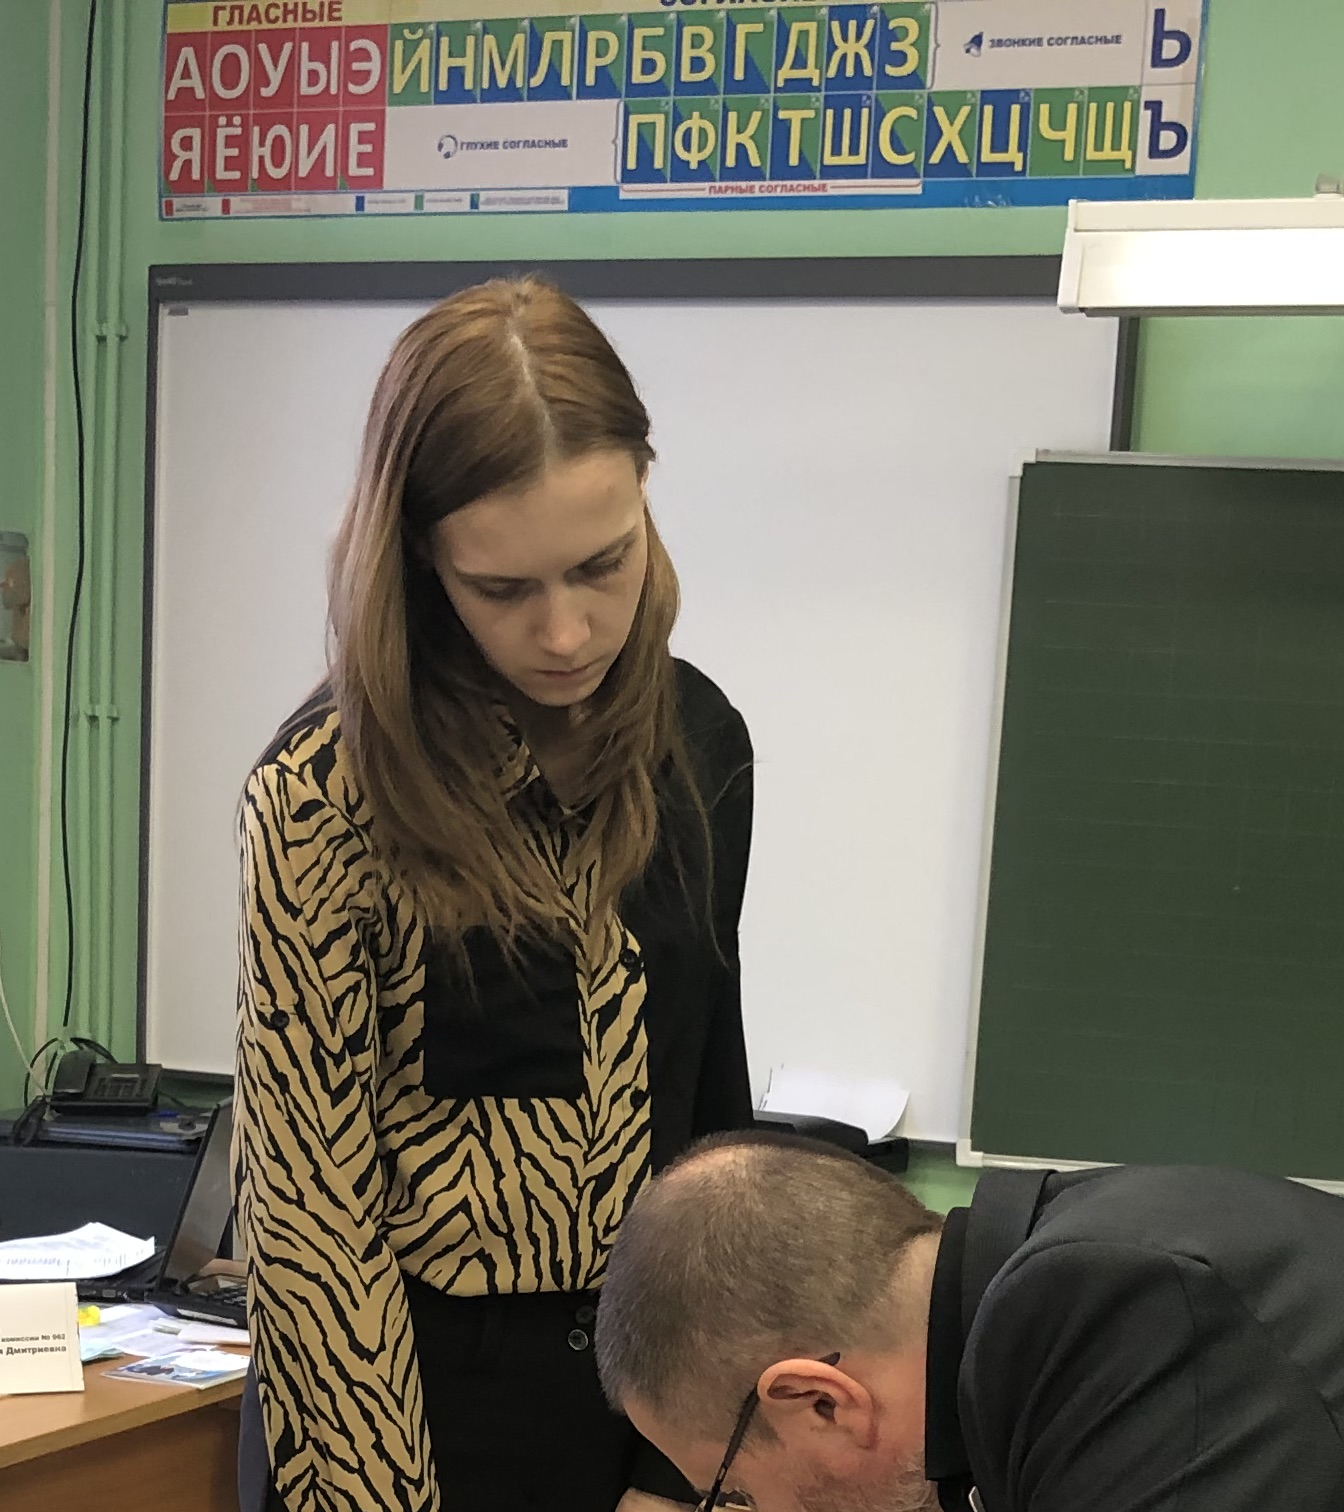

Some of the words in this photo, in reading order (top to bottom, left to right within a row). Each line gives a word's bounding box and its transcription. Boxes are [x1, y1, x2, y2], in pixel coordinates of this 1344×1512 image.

[212, 1, 343, 26] ГЛАСНЫЕ
[989, 37, 1044, 49] ЗВОНКИЕ
[1047, 34, 1122, 47] СОГЛАСНЫЕ
[460, 140, 500, 151] ГЛУХИЕ
[503, 138, 569, 150] СОГЛАСНЫЕ
[709, 183, 755, 194] ПАРНЫЕ
[758, 183, 828, 193] СОГЛАСНЫЕ
[1, 1335, 39, 1343] комиссии
[5, 1345, 67, 1356] Дмитриевна
